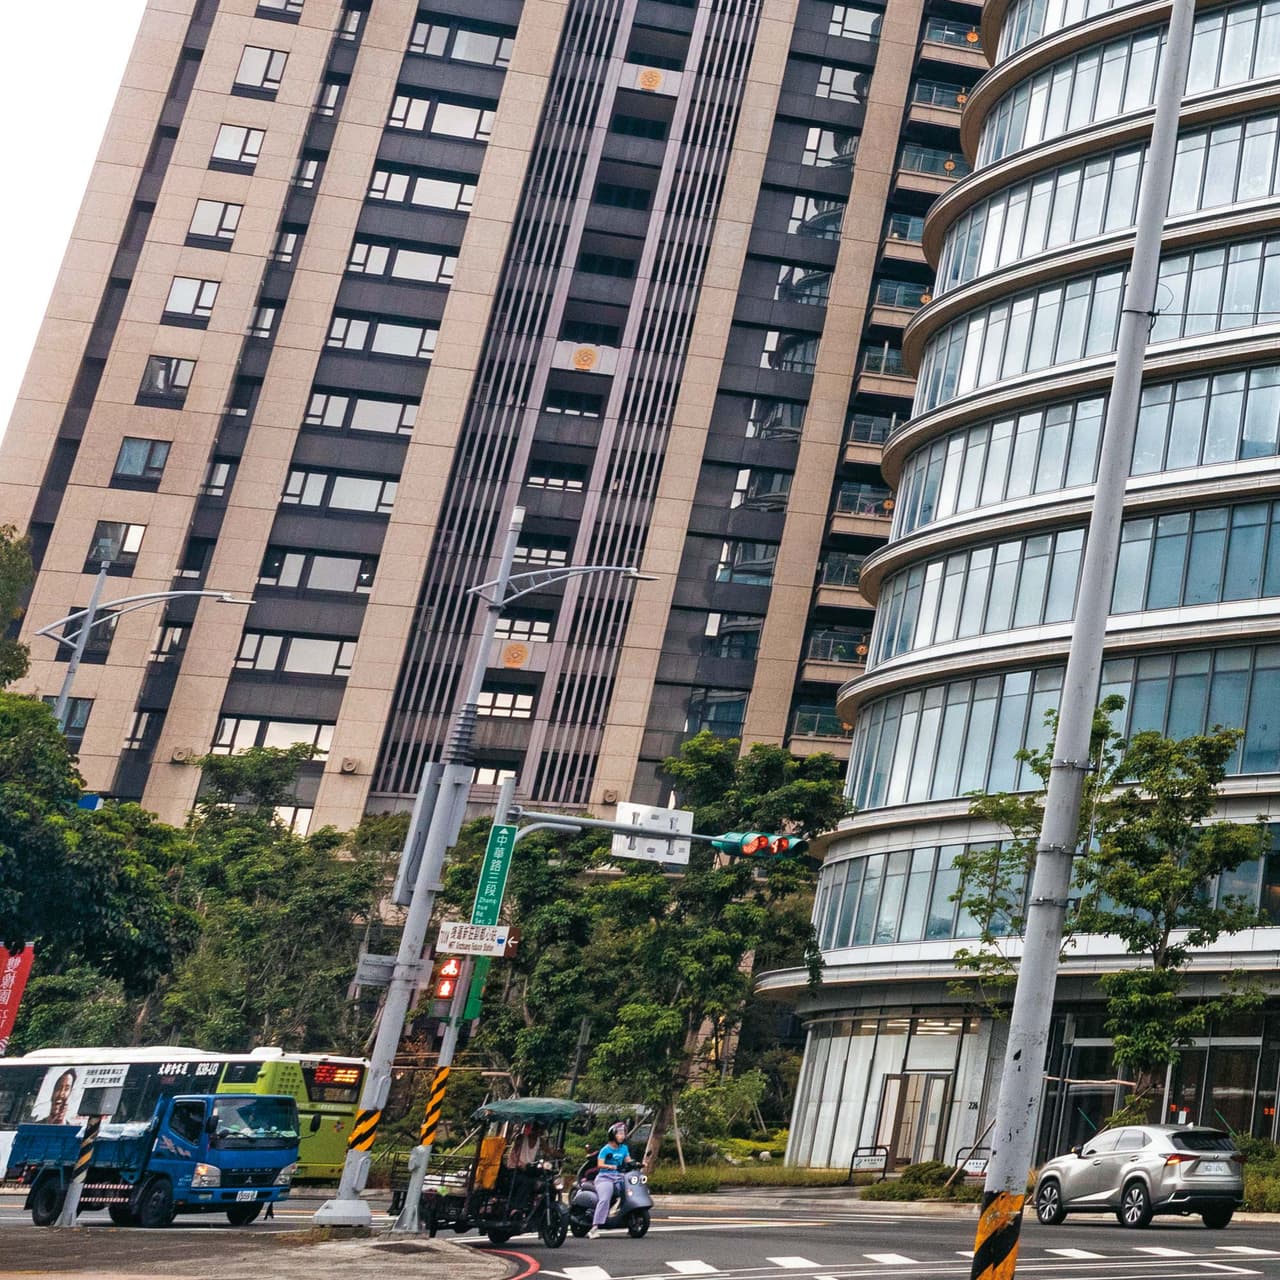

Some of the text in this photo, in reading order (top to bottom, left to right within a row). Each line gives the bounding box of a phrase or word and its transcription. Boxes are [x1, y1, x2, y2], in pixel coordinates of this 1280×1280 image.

[484, 835, 507, 896] 中華路三段
